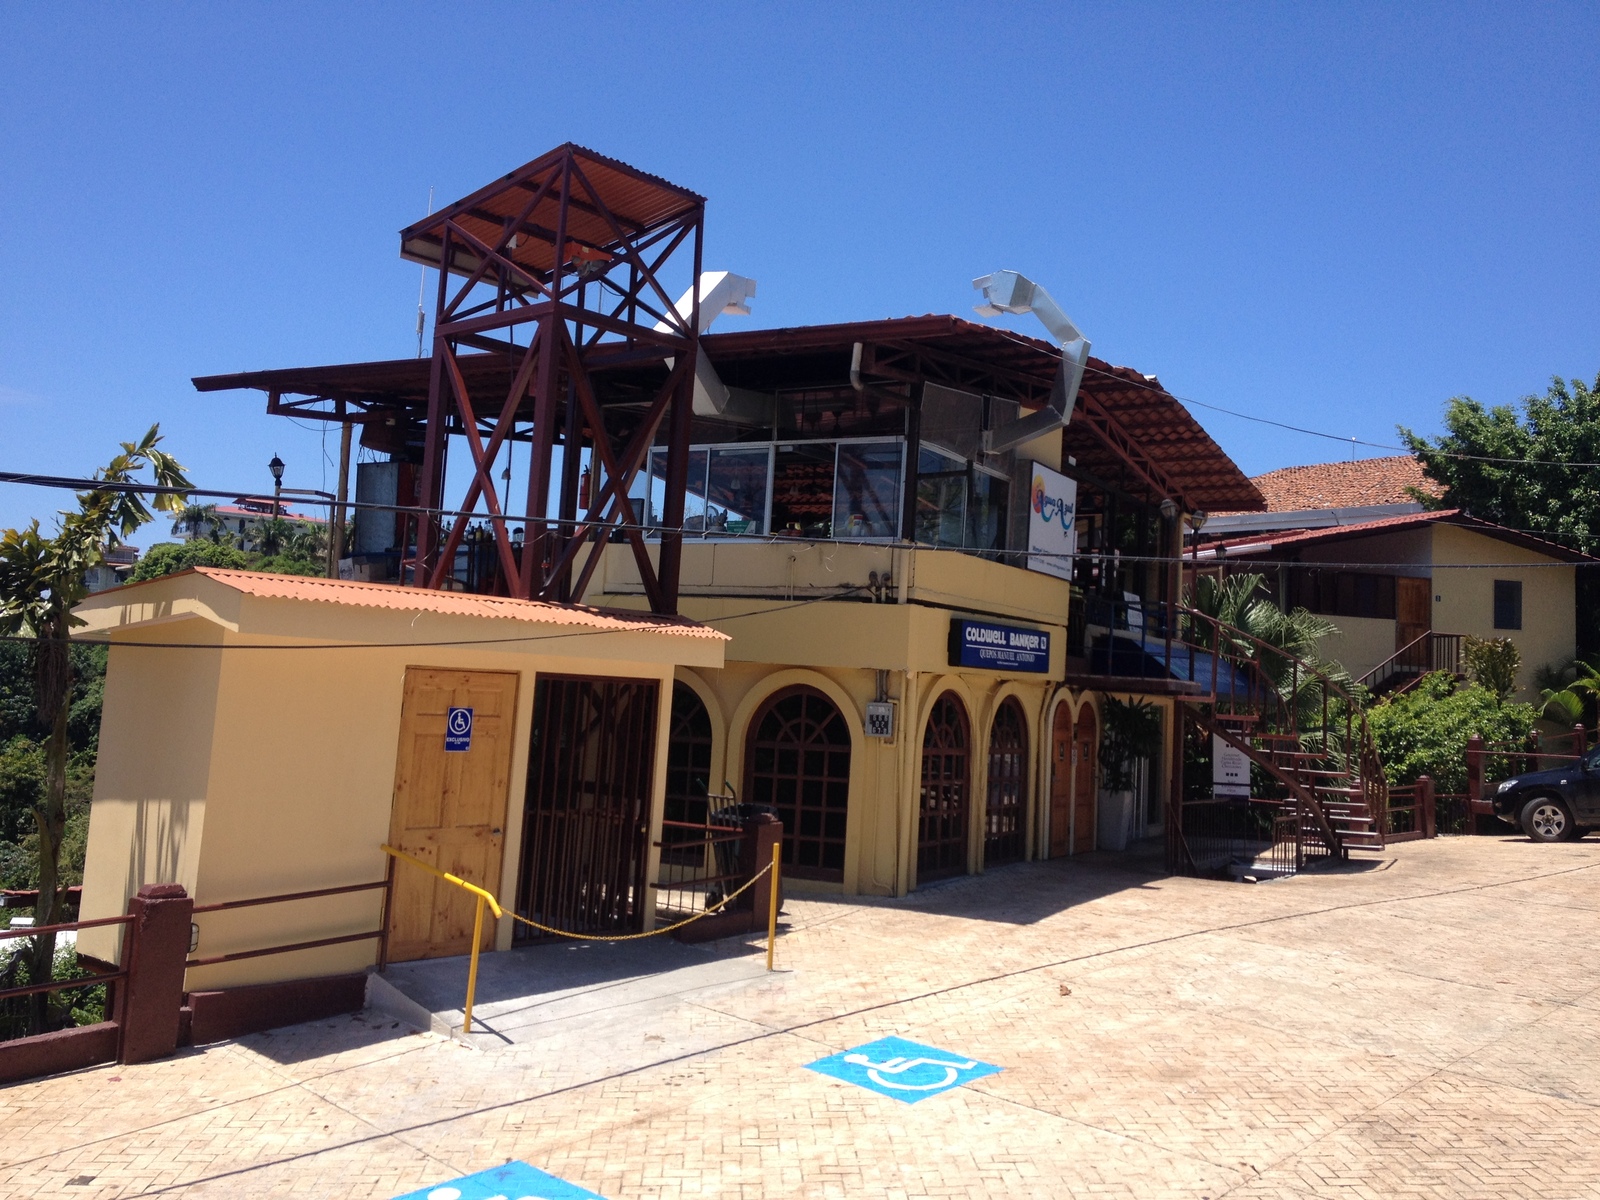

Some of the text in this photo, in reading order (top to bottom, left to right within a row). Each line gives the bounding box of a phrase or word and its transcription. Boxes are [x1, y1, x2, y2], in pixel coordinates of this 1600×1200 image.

[1034, 489, 1074, 530] Agua Azul
[966, 627, 1007, 645] COLDWELL
[1009, 632, 1040, 650] BANKER
[979, 649, 1035, 663] QUEPOS MANUEL ANTONIO
